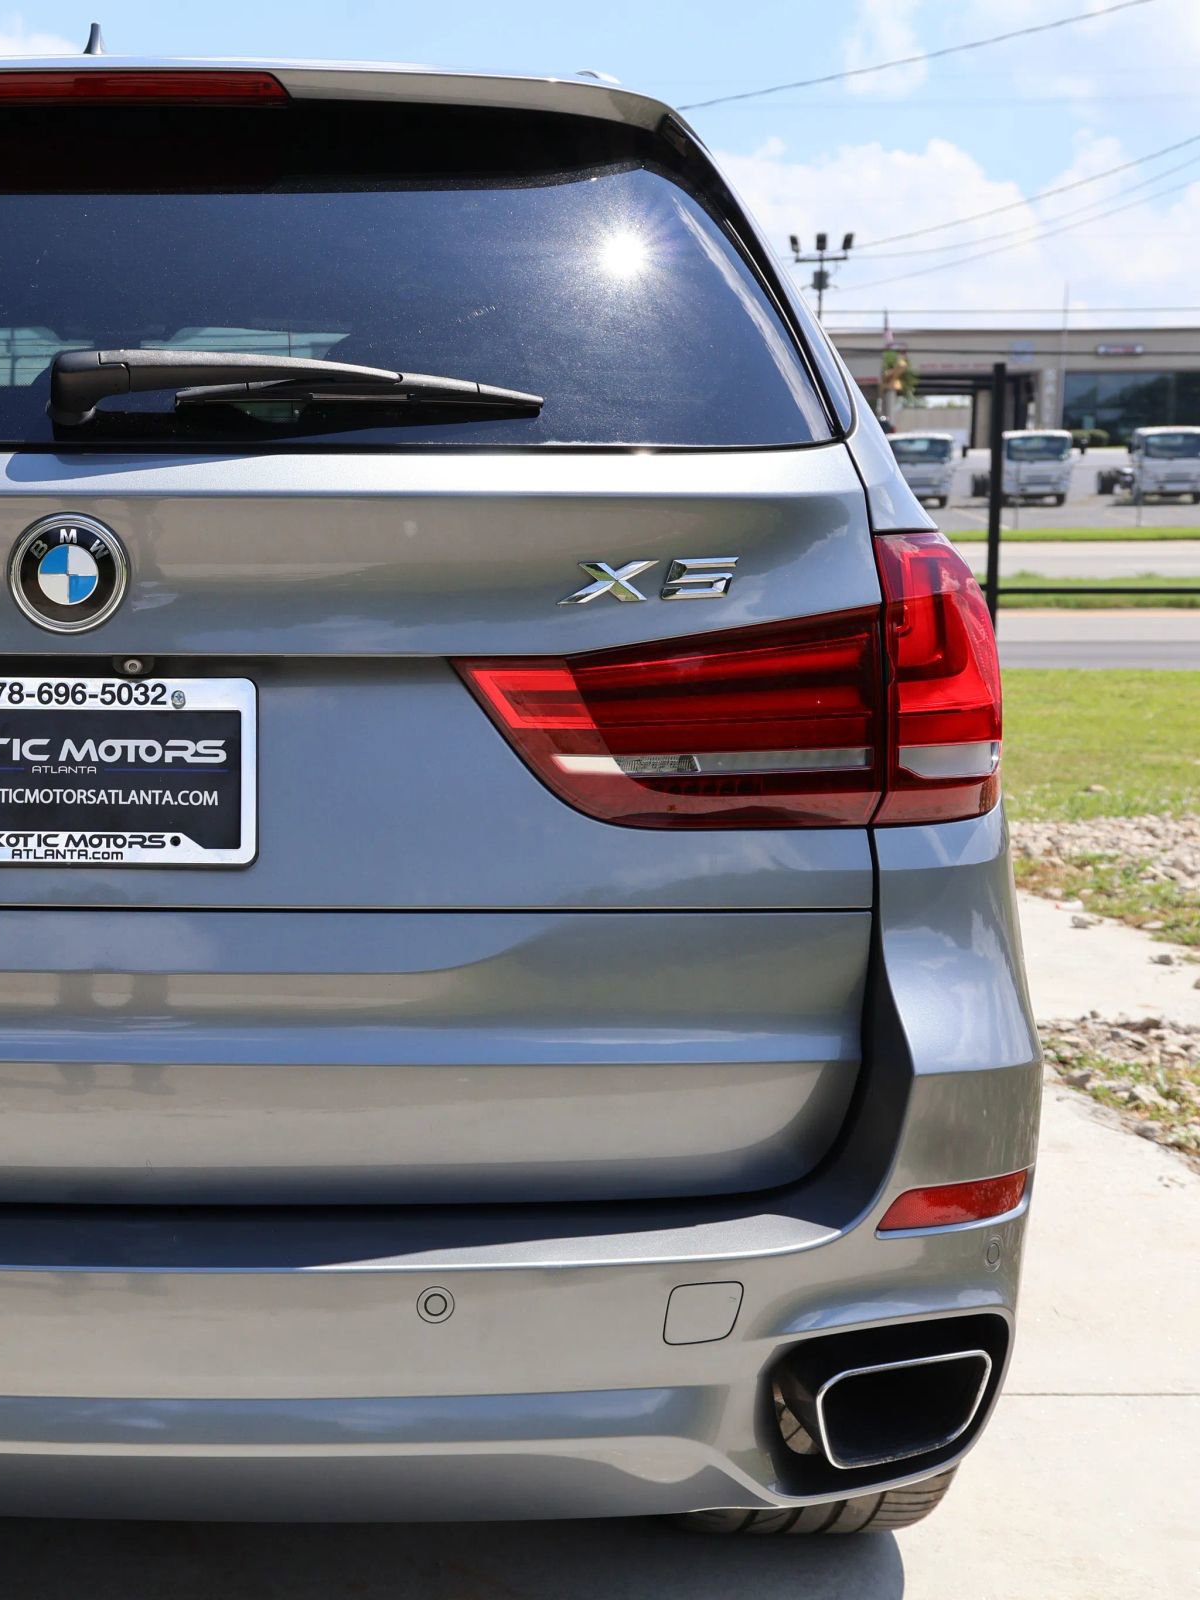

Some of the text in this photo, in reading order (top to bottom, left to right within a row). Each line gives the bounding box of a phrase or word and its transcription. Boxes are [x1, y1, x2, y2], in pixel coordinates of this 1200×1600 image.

[30, 529, 110, 560] BMW
[557, 557, 740, 605] X5
[58, 739, 227, 763] MOTORS
[31, 765, 97, 775] ATLANTA
[65, 834, 166, 849] MOTORS
[11, 849, 123, 860] ATLANTA.com
